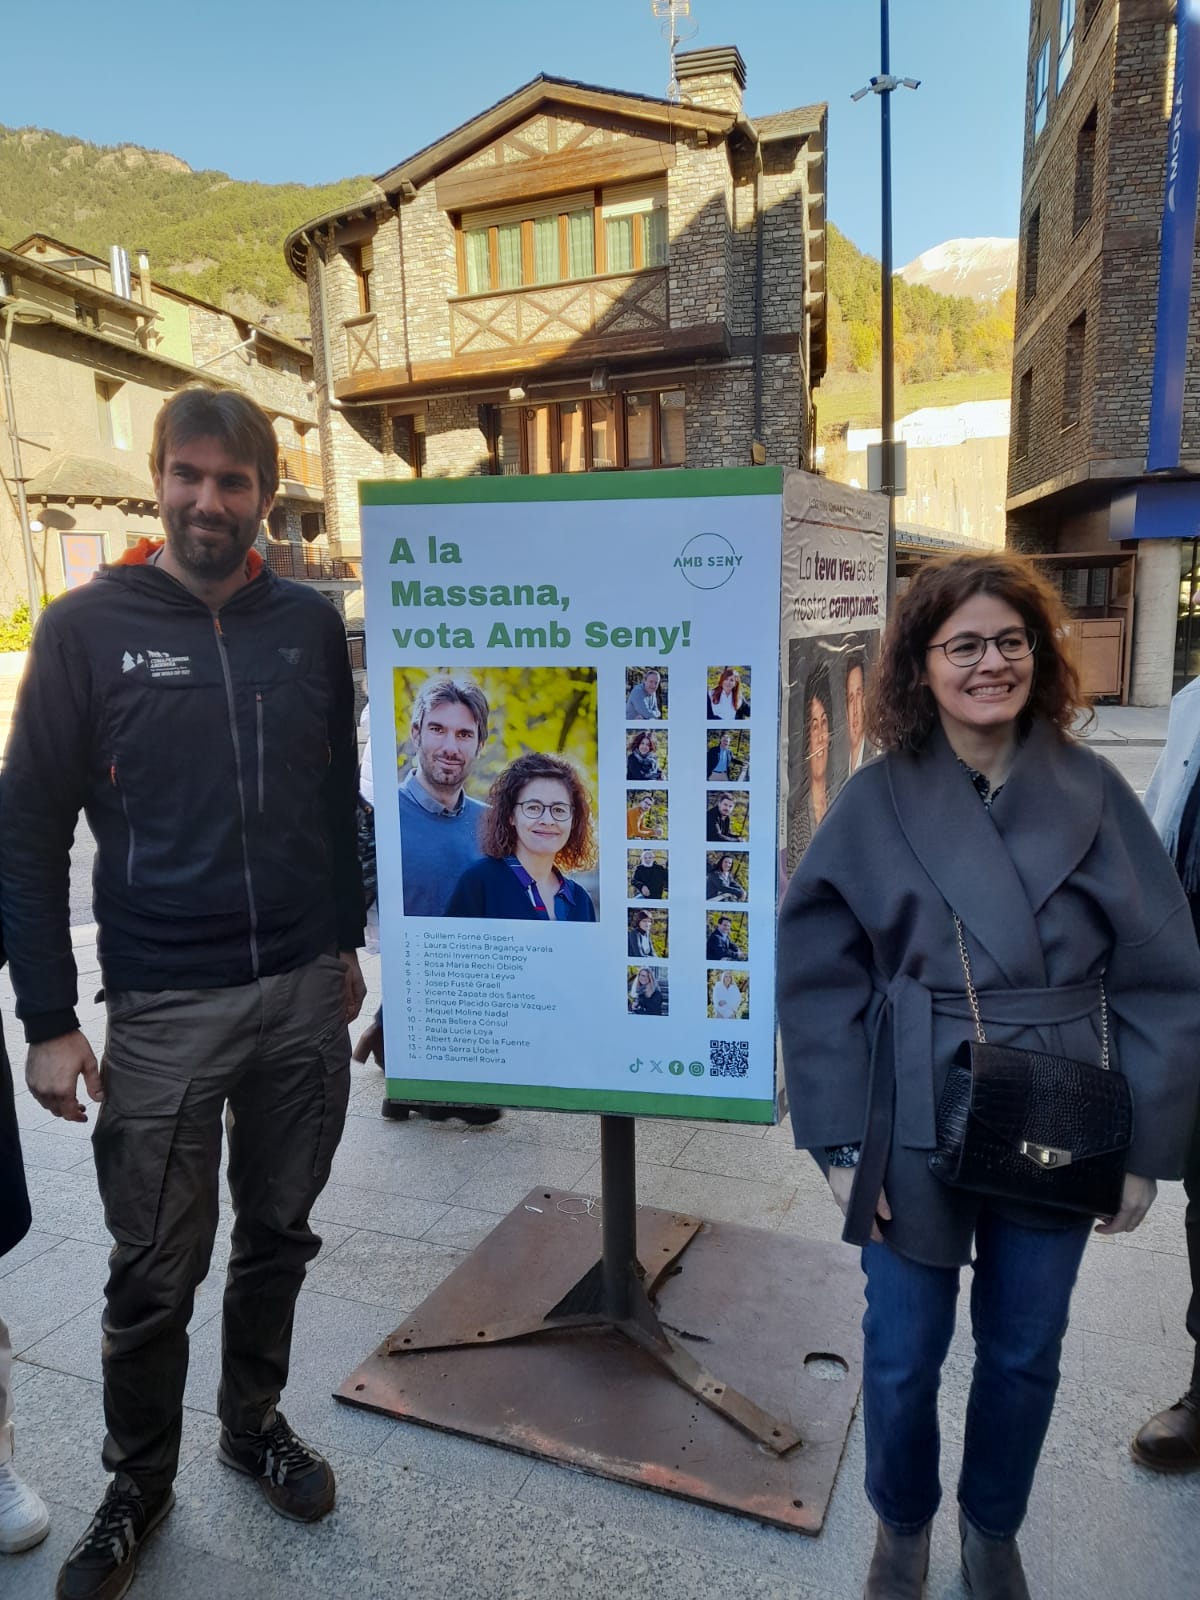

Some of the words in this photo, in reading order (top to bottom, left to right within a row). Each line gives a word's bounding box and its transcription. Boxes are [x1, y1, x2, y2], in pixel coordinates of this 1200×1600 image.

[389, 537, 416, 564] A
[428, 535, 463, 564] la
[673, 556, 703, 568] AMB
[707, 555, 743, 567] SENY
[814, 550, 837, 580] teva
[839, 558, 856, 581] veu
[391, 580, 570, 612] Massana,
[793, 592, 827, 621] nostre
[392, 622, 475, 649] vota
[486, 620, 571, 649] Amb
[585, 620, 691, 655] Seny!
[423, 932, 455, 940] Guillem
[483, 934, 515, 943] Gispert
[449, 943, 482, 951] Cristina
[484, 944, 524, 953] Bragança
[423, 951, 451, 959] Antoni
[491, 954, 528, 963] Campoy
[496, 963, 524, 971] Obiols
[447, 971, 490, 980] Mosquera
[491, 973, 516, 981] Leyva
[425, 980, 449, 988] Josep
[424, 989, 456, 997] Vicente
[506, 992, 536, 1000] Santos
[425, 999, 457, 1008] Enrique
[425, 1008, 453, 1017] Miquel
[484, 1010, 509, 1018] Nadal
[425, 1017, 447, 1025] Anna
[473, 1028, 493, 1037] Loya
[425, 1036, 451, 1044] Albert
[452, 1037, 477, 1045] Areny
[501, 1038, 530, 1046] Fuente
[425, 1045, 447, 1053] Anna
[425, 1054, 443, 1062] Ona
[445, 1055, 478, 1063] Saumell
[479, 1056, 506, 1064] Rovira
